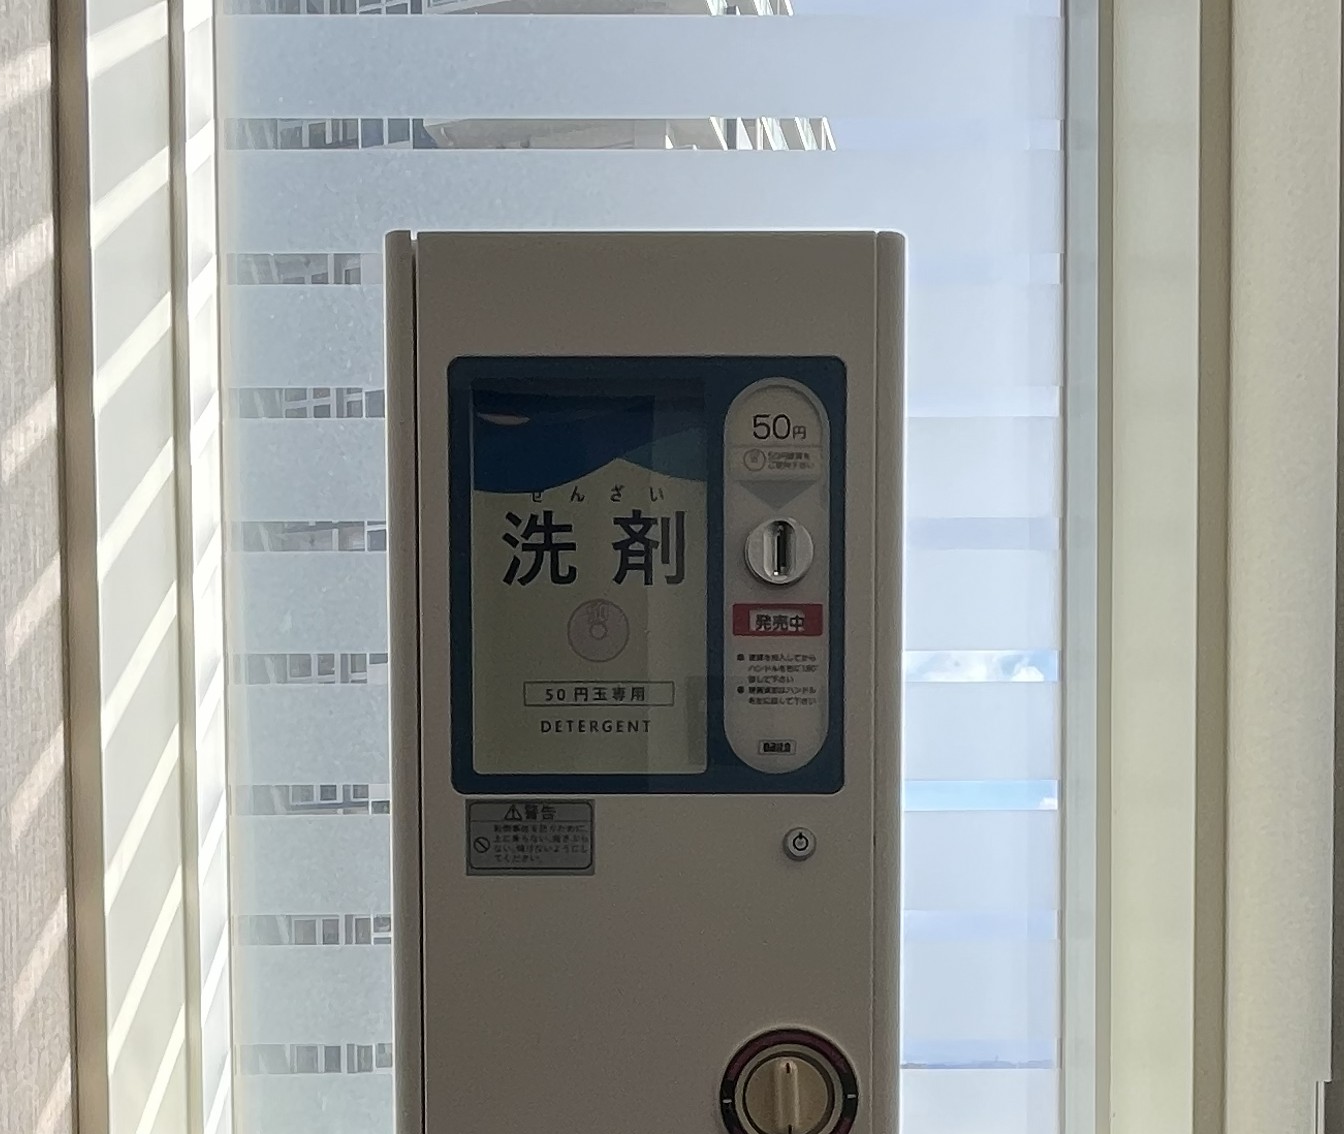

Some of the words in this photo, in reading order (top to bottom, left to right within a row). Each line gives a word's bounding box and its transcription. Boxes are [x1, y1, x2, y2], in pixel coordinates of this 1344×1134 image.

[752, 413, 806, 441] 50円
[502, 508, 686, 586] 洗剤
[756, 614, 805, 633] 発売中
[540, 719, 652, 733] DETERGENT
[524, 804, 556, 820] 警告
